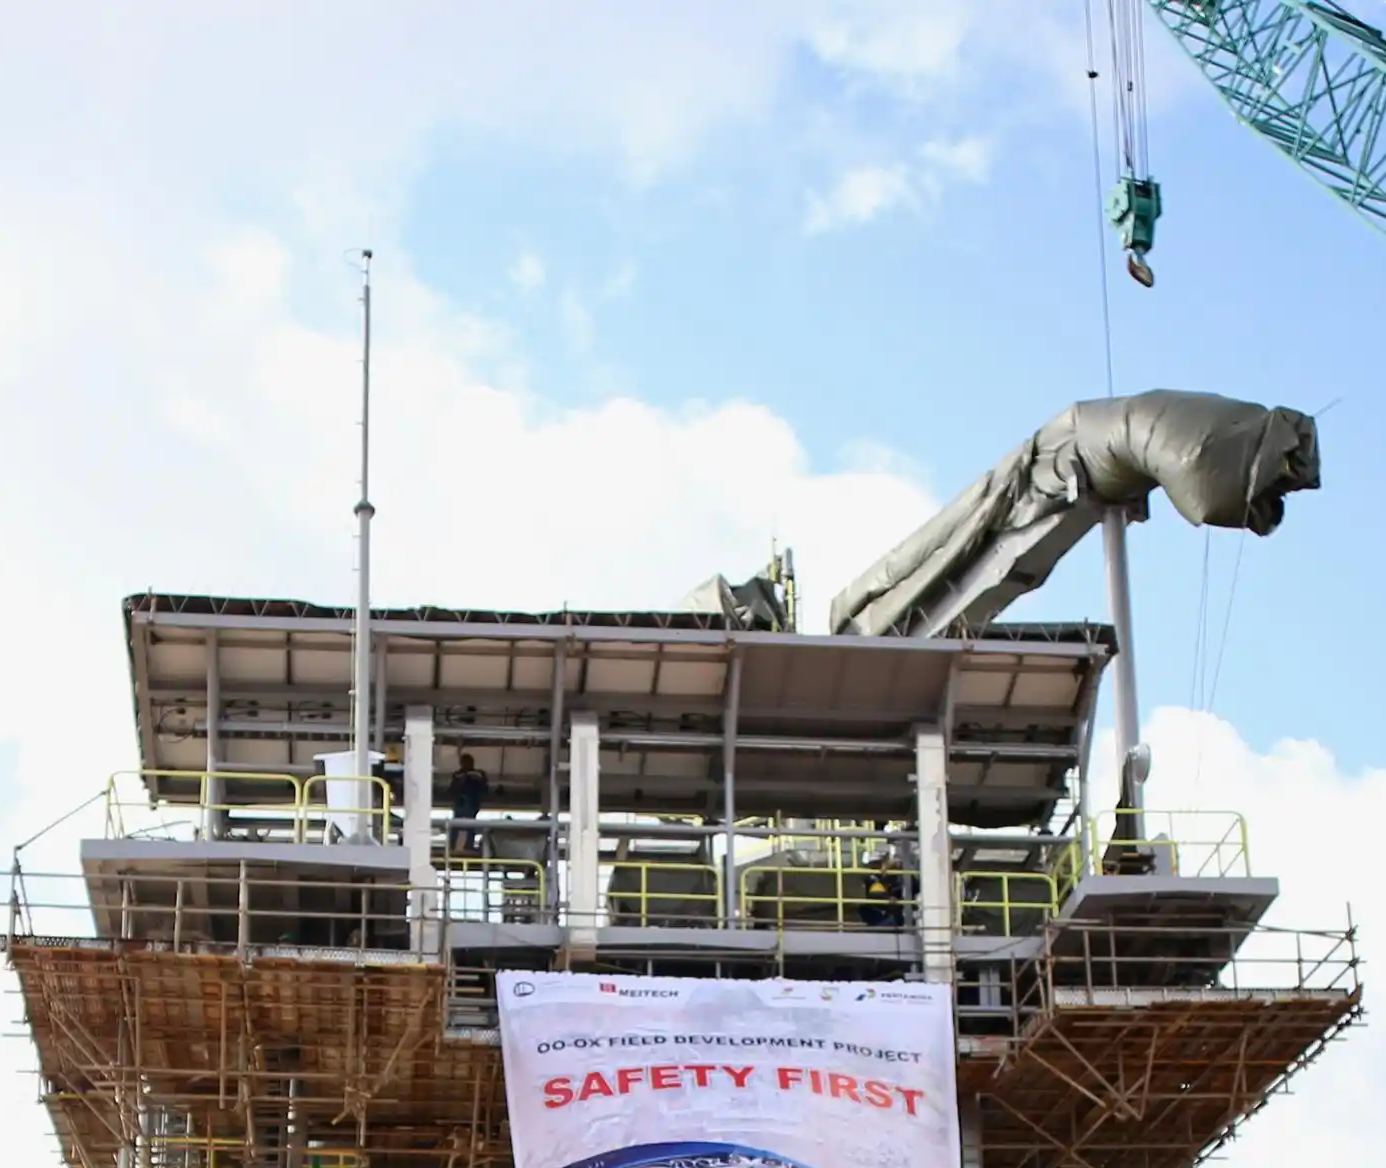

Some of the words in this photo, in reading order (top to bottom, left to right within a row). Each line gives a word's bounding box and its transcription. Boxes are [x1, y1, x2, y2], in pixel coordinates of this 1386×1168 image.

[619, 988, 679, 998] MEITECH
[609, 1034, 666, 1048] FIELD
[674, 1035, 825, 1049] DEVELOPMENT
[834, 1041, 922, 1063] PROJECT
[543, 1064, 755, 1109] SAFETY
[777, 1067, 924, 1116] FIRST
